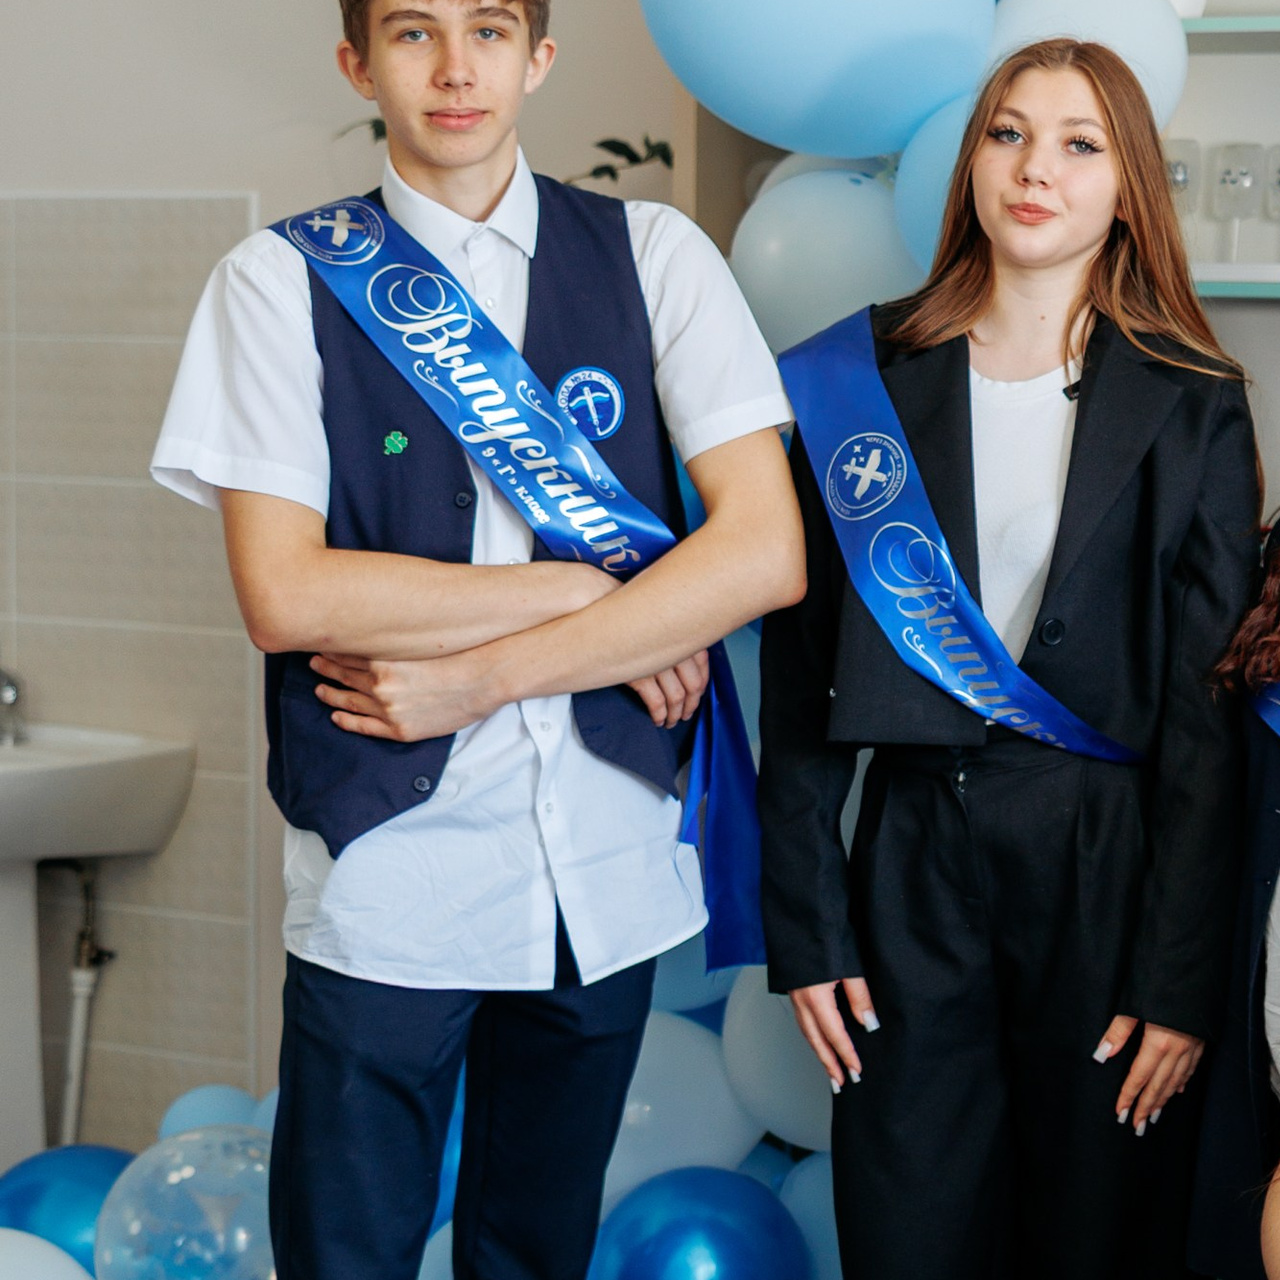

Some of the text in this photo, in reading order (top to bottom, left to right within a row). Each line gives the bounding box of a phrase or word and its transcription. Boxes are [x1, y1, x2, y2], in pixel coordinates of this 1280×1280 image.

[367, 263, 641, 572] Выпускник
[482, 446, 496, 457] 9
[515, 486, 550, 524] класс
[869, 522, 1067, 748] Выпуск
